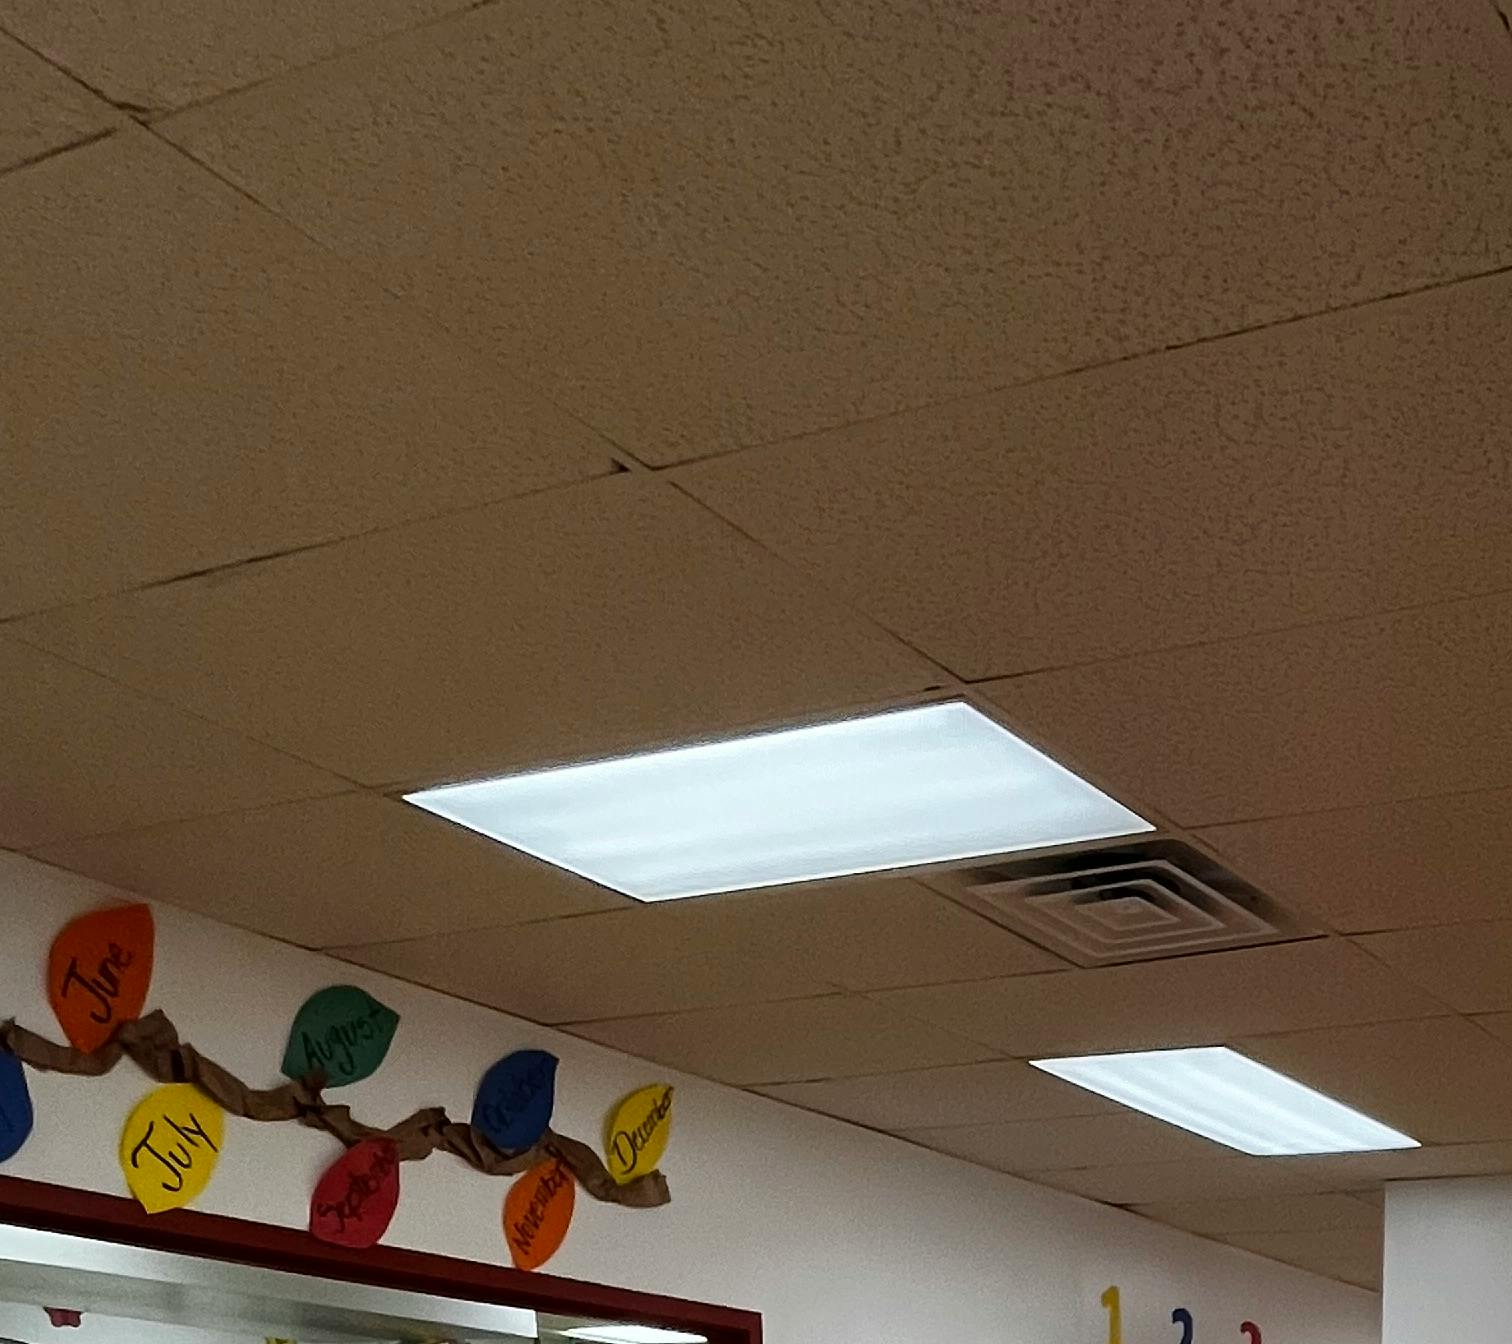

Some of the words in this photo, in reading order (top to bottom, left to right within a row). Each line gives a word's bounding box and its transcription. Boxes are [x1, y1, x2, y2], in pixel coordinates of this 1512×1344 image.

[62, 940, 135, 1024] June
[302, 1005, 392, 1074] August
[132, 1107, 219, 1193] July
